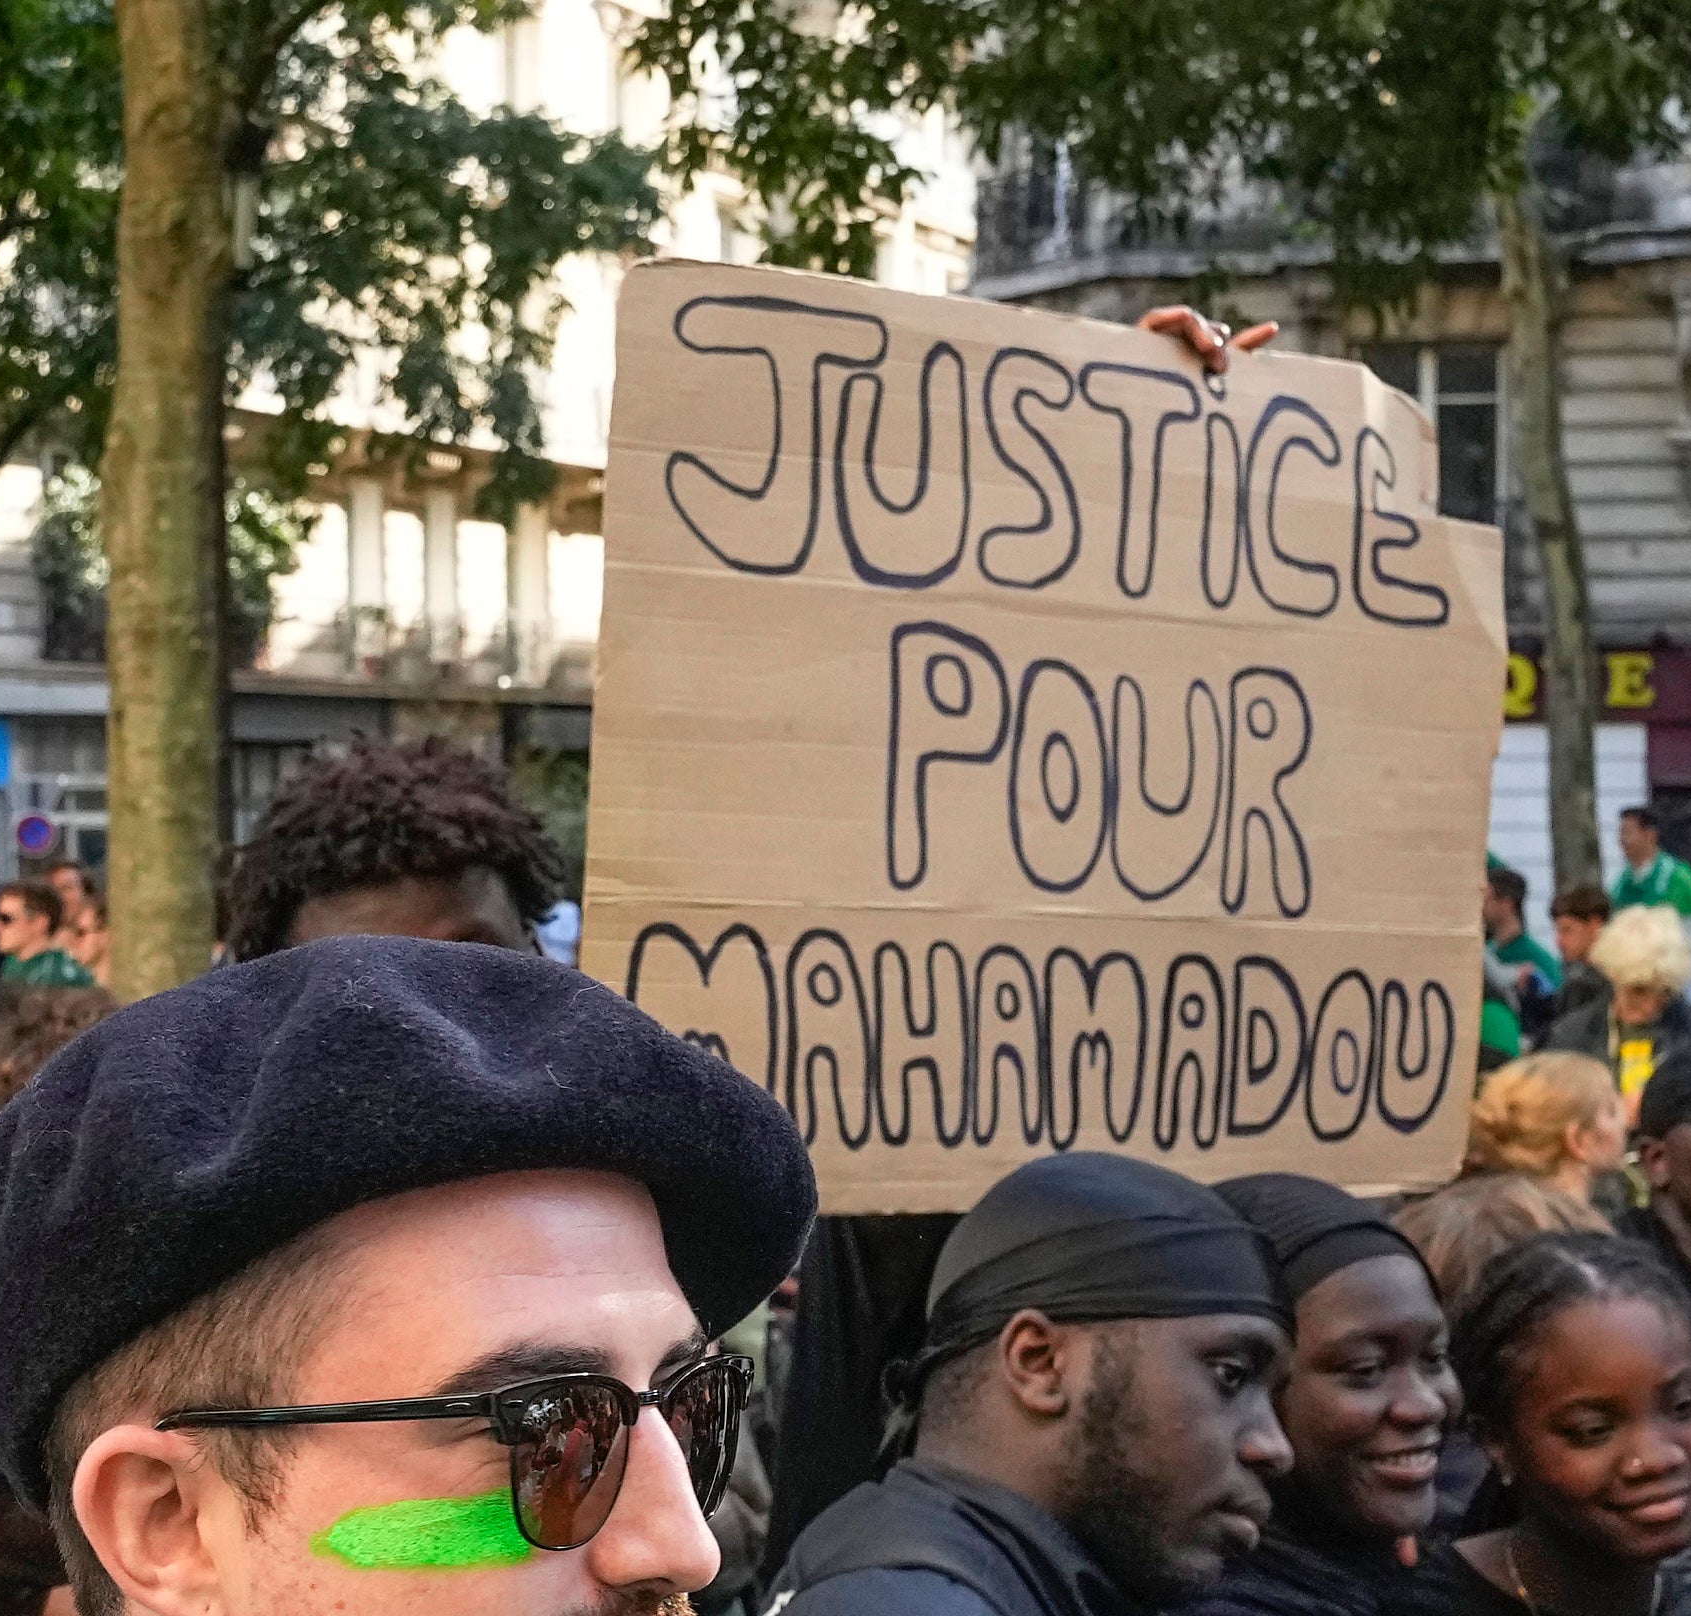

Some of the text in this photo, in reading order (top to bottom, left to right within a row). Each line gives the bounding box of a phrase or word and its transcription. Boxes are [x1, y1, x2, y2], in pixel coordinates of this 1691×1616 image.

[665, 294, 1451, 627] JUSTICE
[886, 620, 1314, 917] POUR
[626, 921, 1455, 1152] MAHAMADOU
